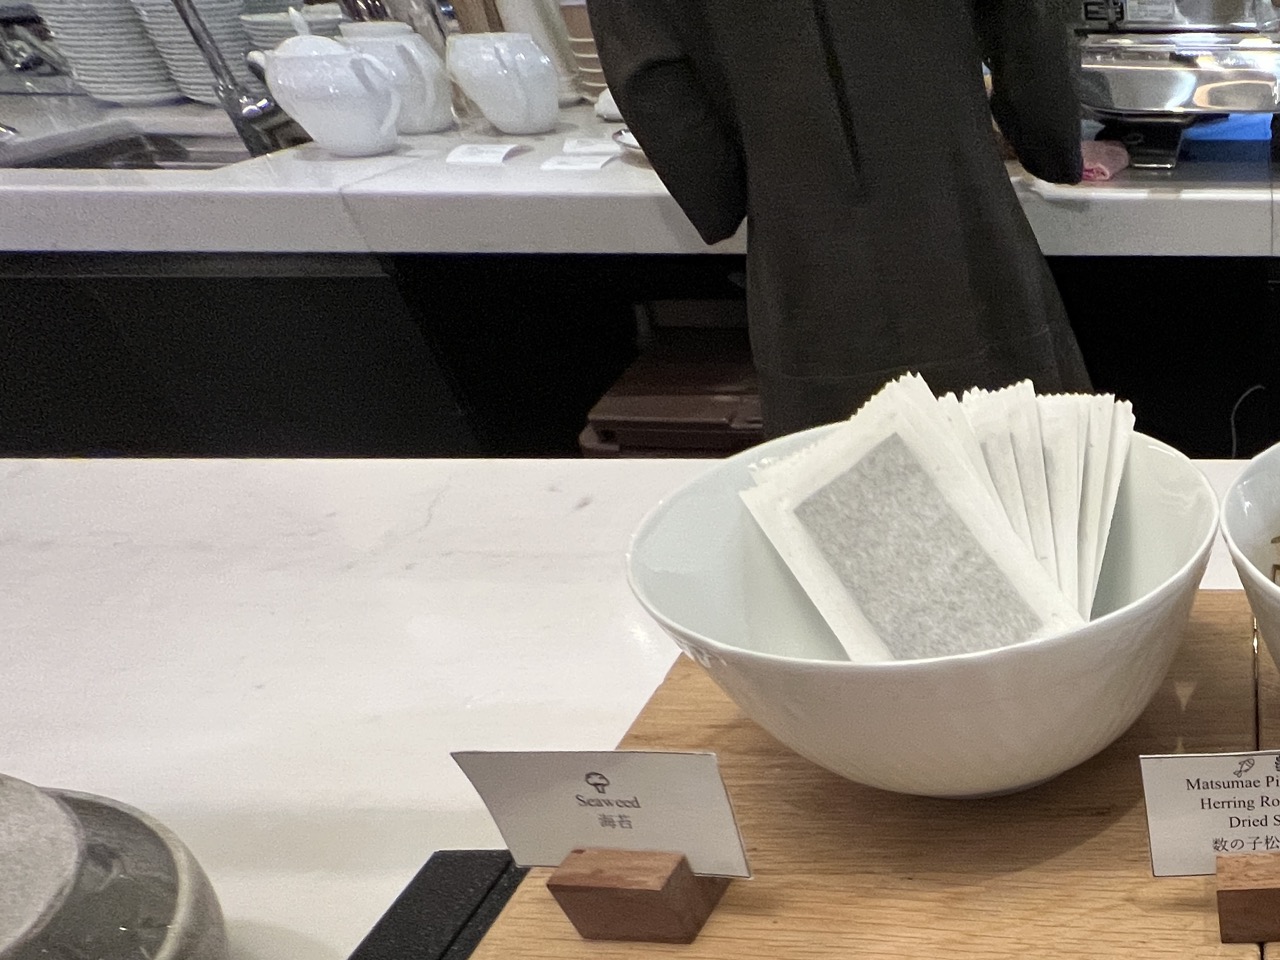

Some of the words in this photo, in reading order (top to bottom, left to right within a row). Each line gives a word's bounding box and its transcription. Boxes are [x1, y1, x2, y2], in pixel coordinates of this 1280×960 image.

[1186, 778, 1261, 791] Matsumae
[1200, 796, 1256, 811] Herring
[1229, 815, 1268, 829] Dried
